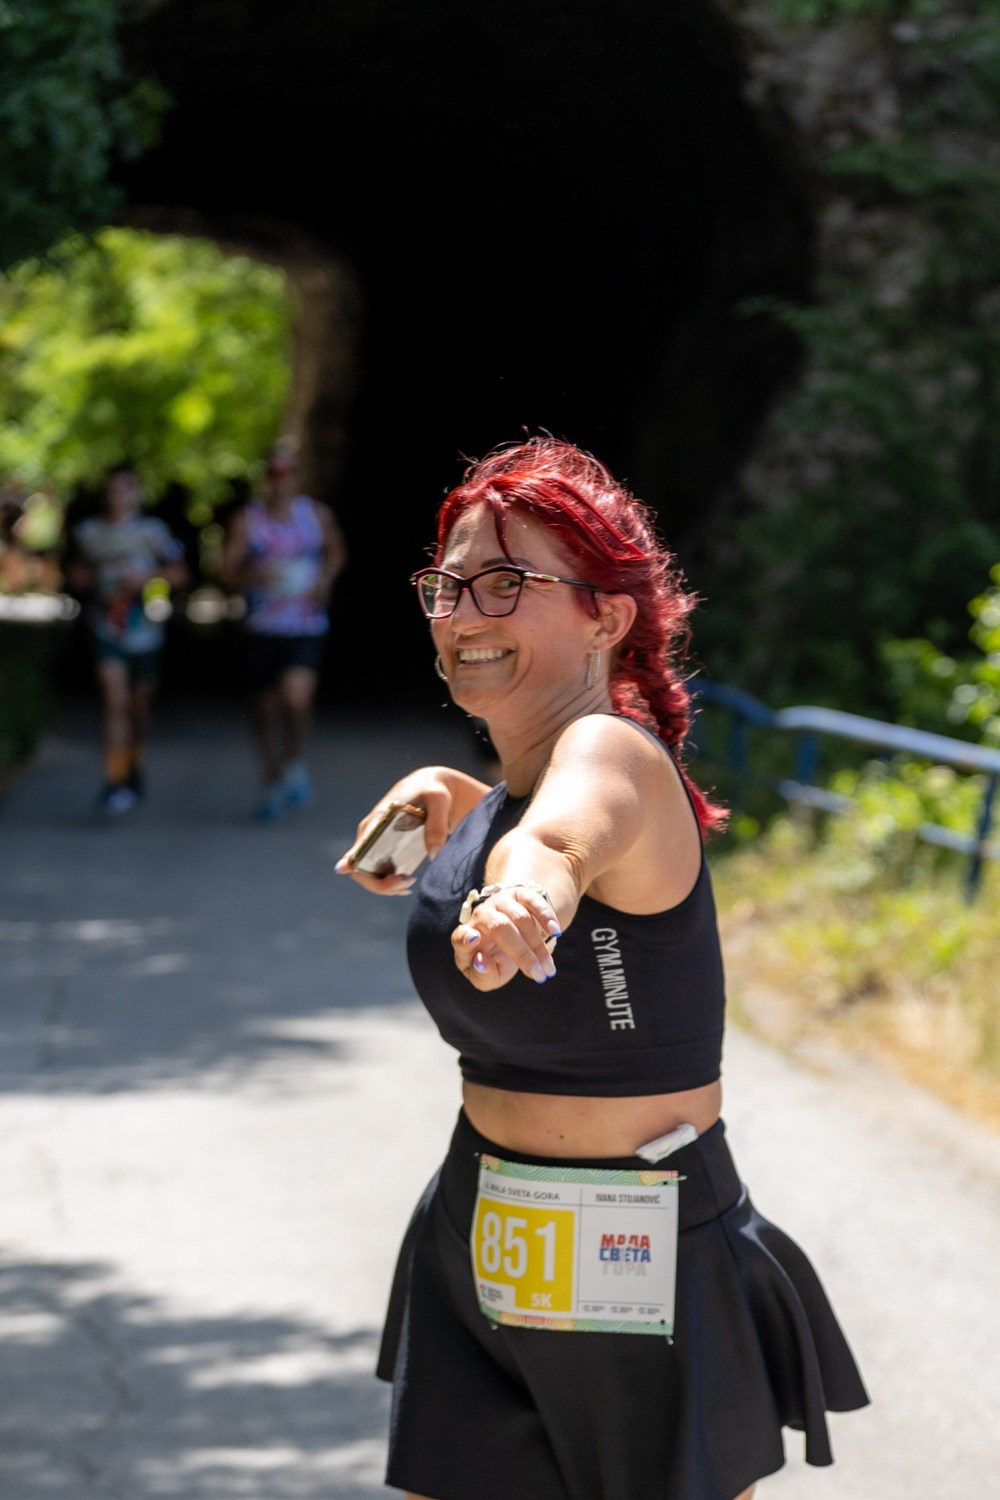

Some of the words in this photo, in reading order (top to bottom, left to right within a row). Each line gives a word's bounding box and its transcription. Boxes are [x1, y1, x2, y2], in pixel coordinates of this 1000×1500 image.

[590, 927, 636, 1031] GYM.MINUTE
[508, 1186, 532, 1199] SVETA
[533, 1190, 561, 1201] GORA
[481, 1211, 557, 1282] 851
[530, 1292, 553, 1308] 5K
